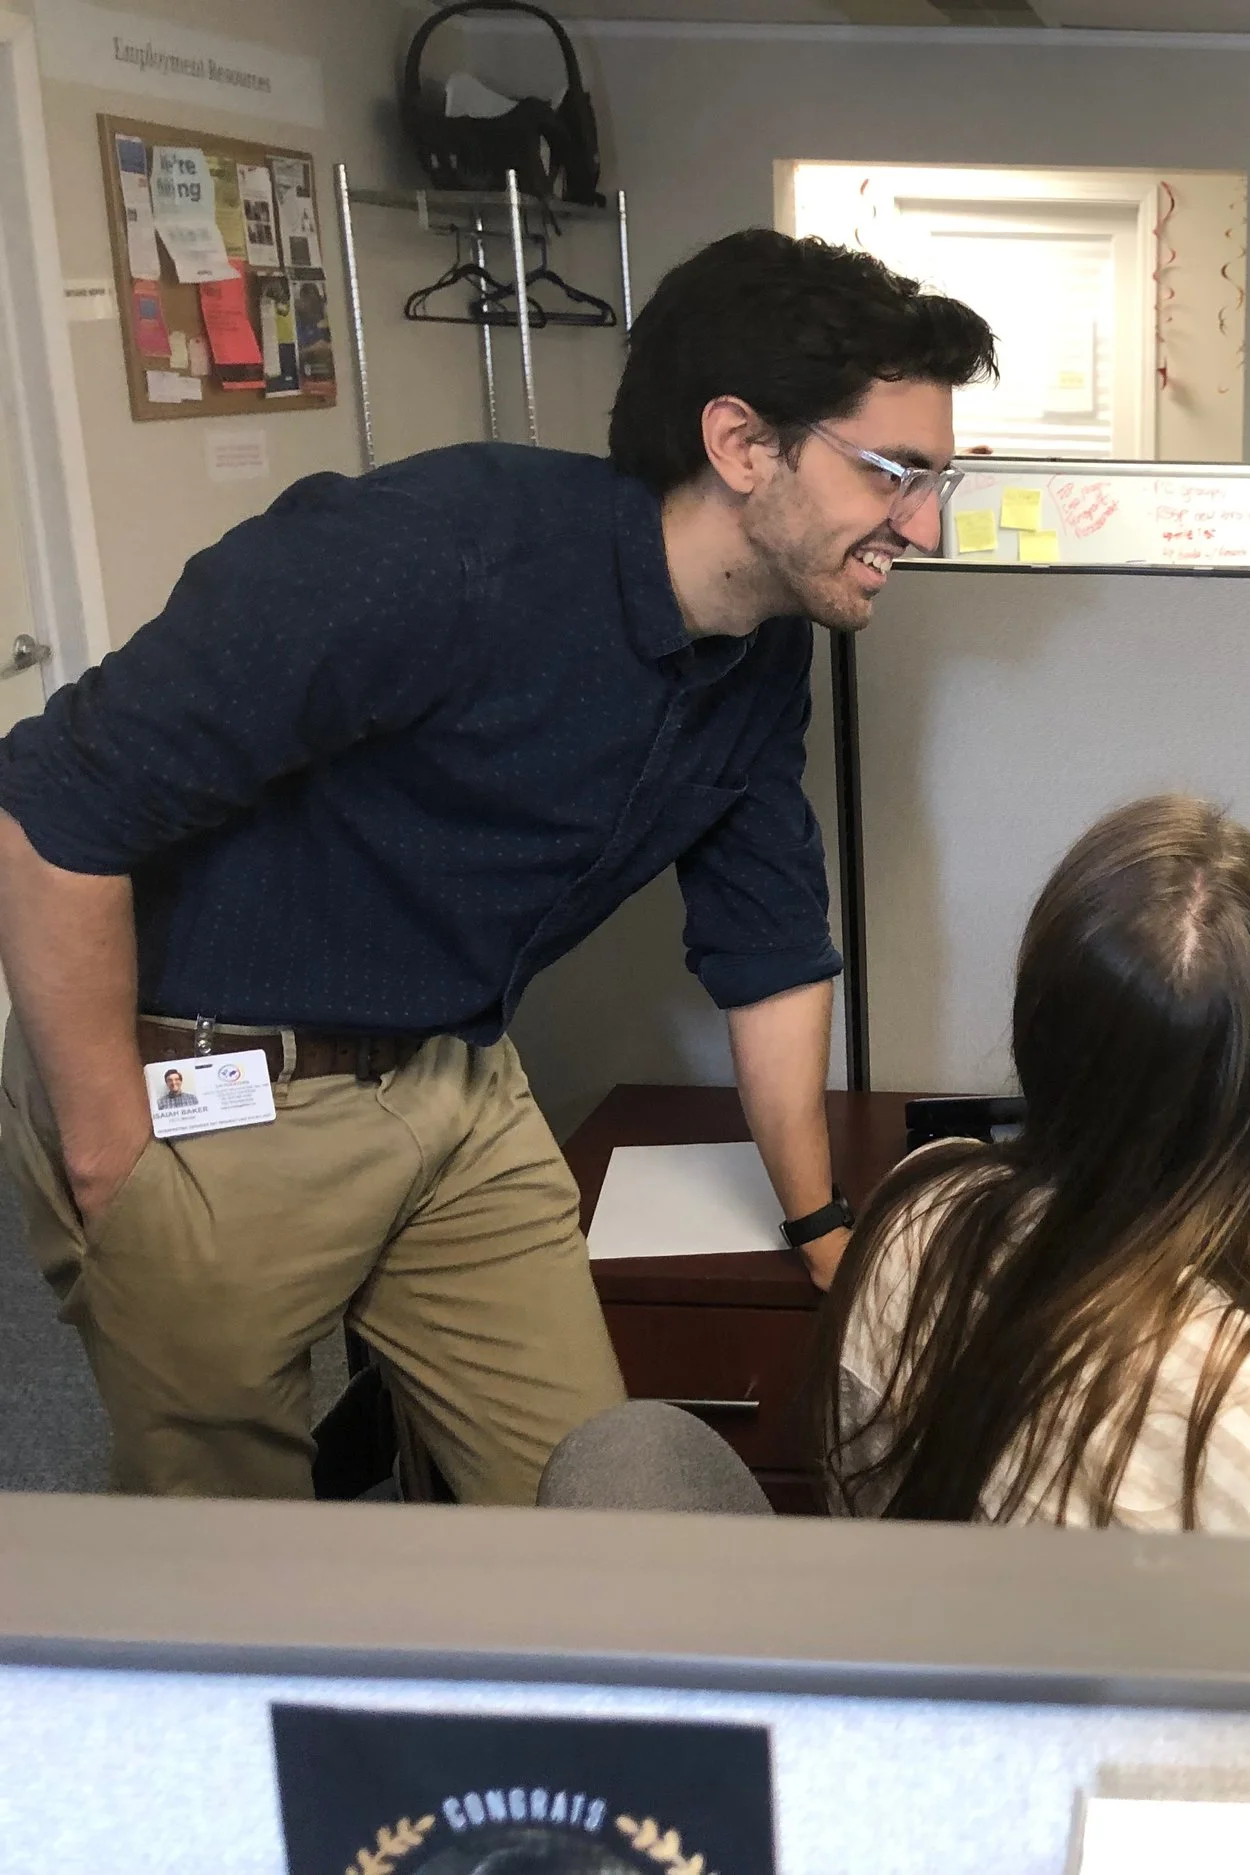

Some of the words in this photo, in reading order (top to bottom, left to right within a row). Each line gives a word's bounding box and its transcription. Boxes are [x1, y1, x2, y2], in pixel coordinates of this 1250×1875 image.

[113, 36, 204, 79] Employment
[207, 58, 272, 93] Resources
[181, 1106, 209, 1116] BAKER
[441, 1786, 608, 1834] CONGRATS
